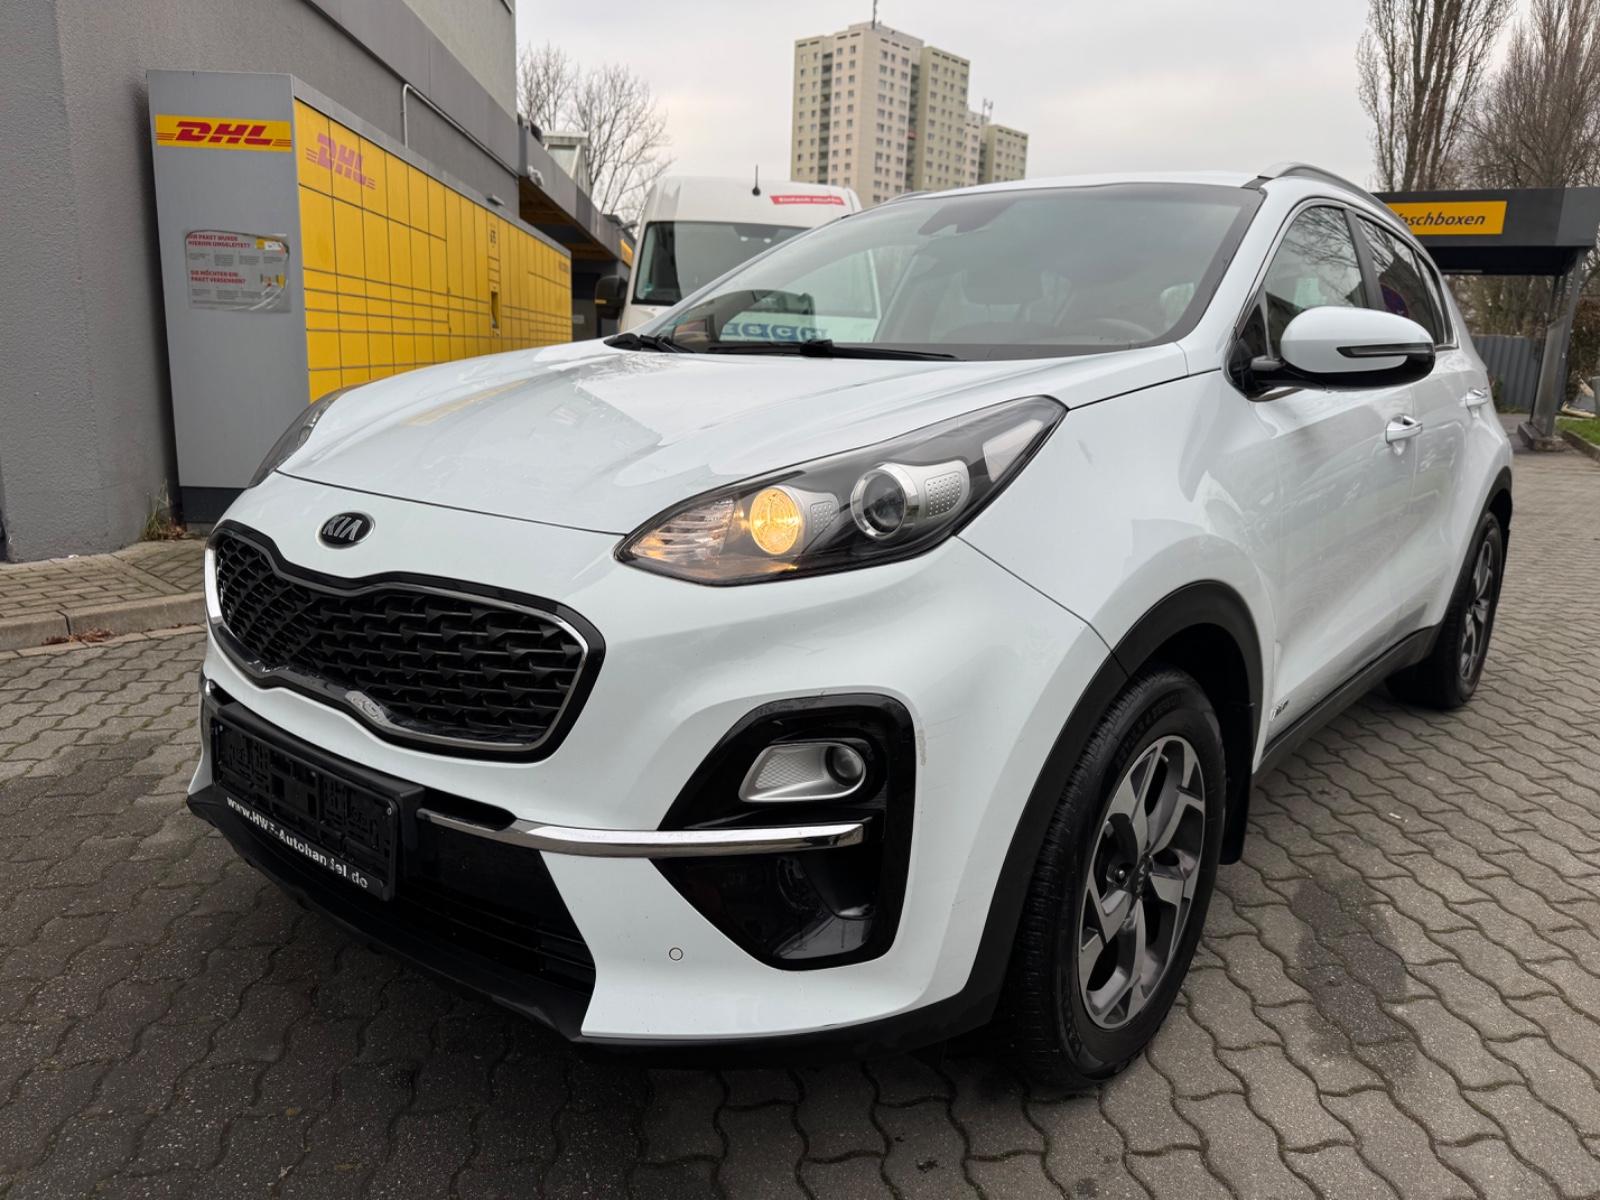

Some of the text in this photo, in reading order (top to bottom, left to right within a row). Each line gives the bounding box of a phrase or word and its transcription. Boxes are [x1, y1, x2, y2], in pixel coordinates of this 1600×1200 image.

[175, 121, 273, 146] DHL
[316, 131, 366, 186] DHL
[1398, 211, 1486, 226] aschboxen
[322, 516, 362, 541] KIA
